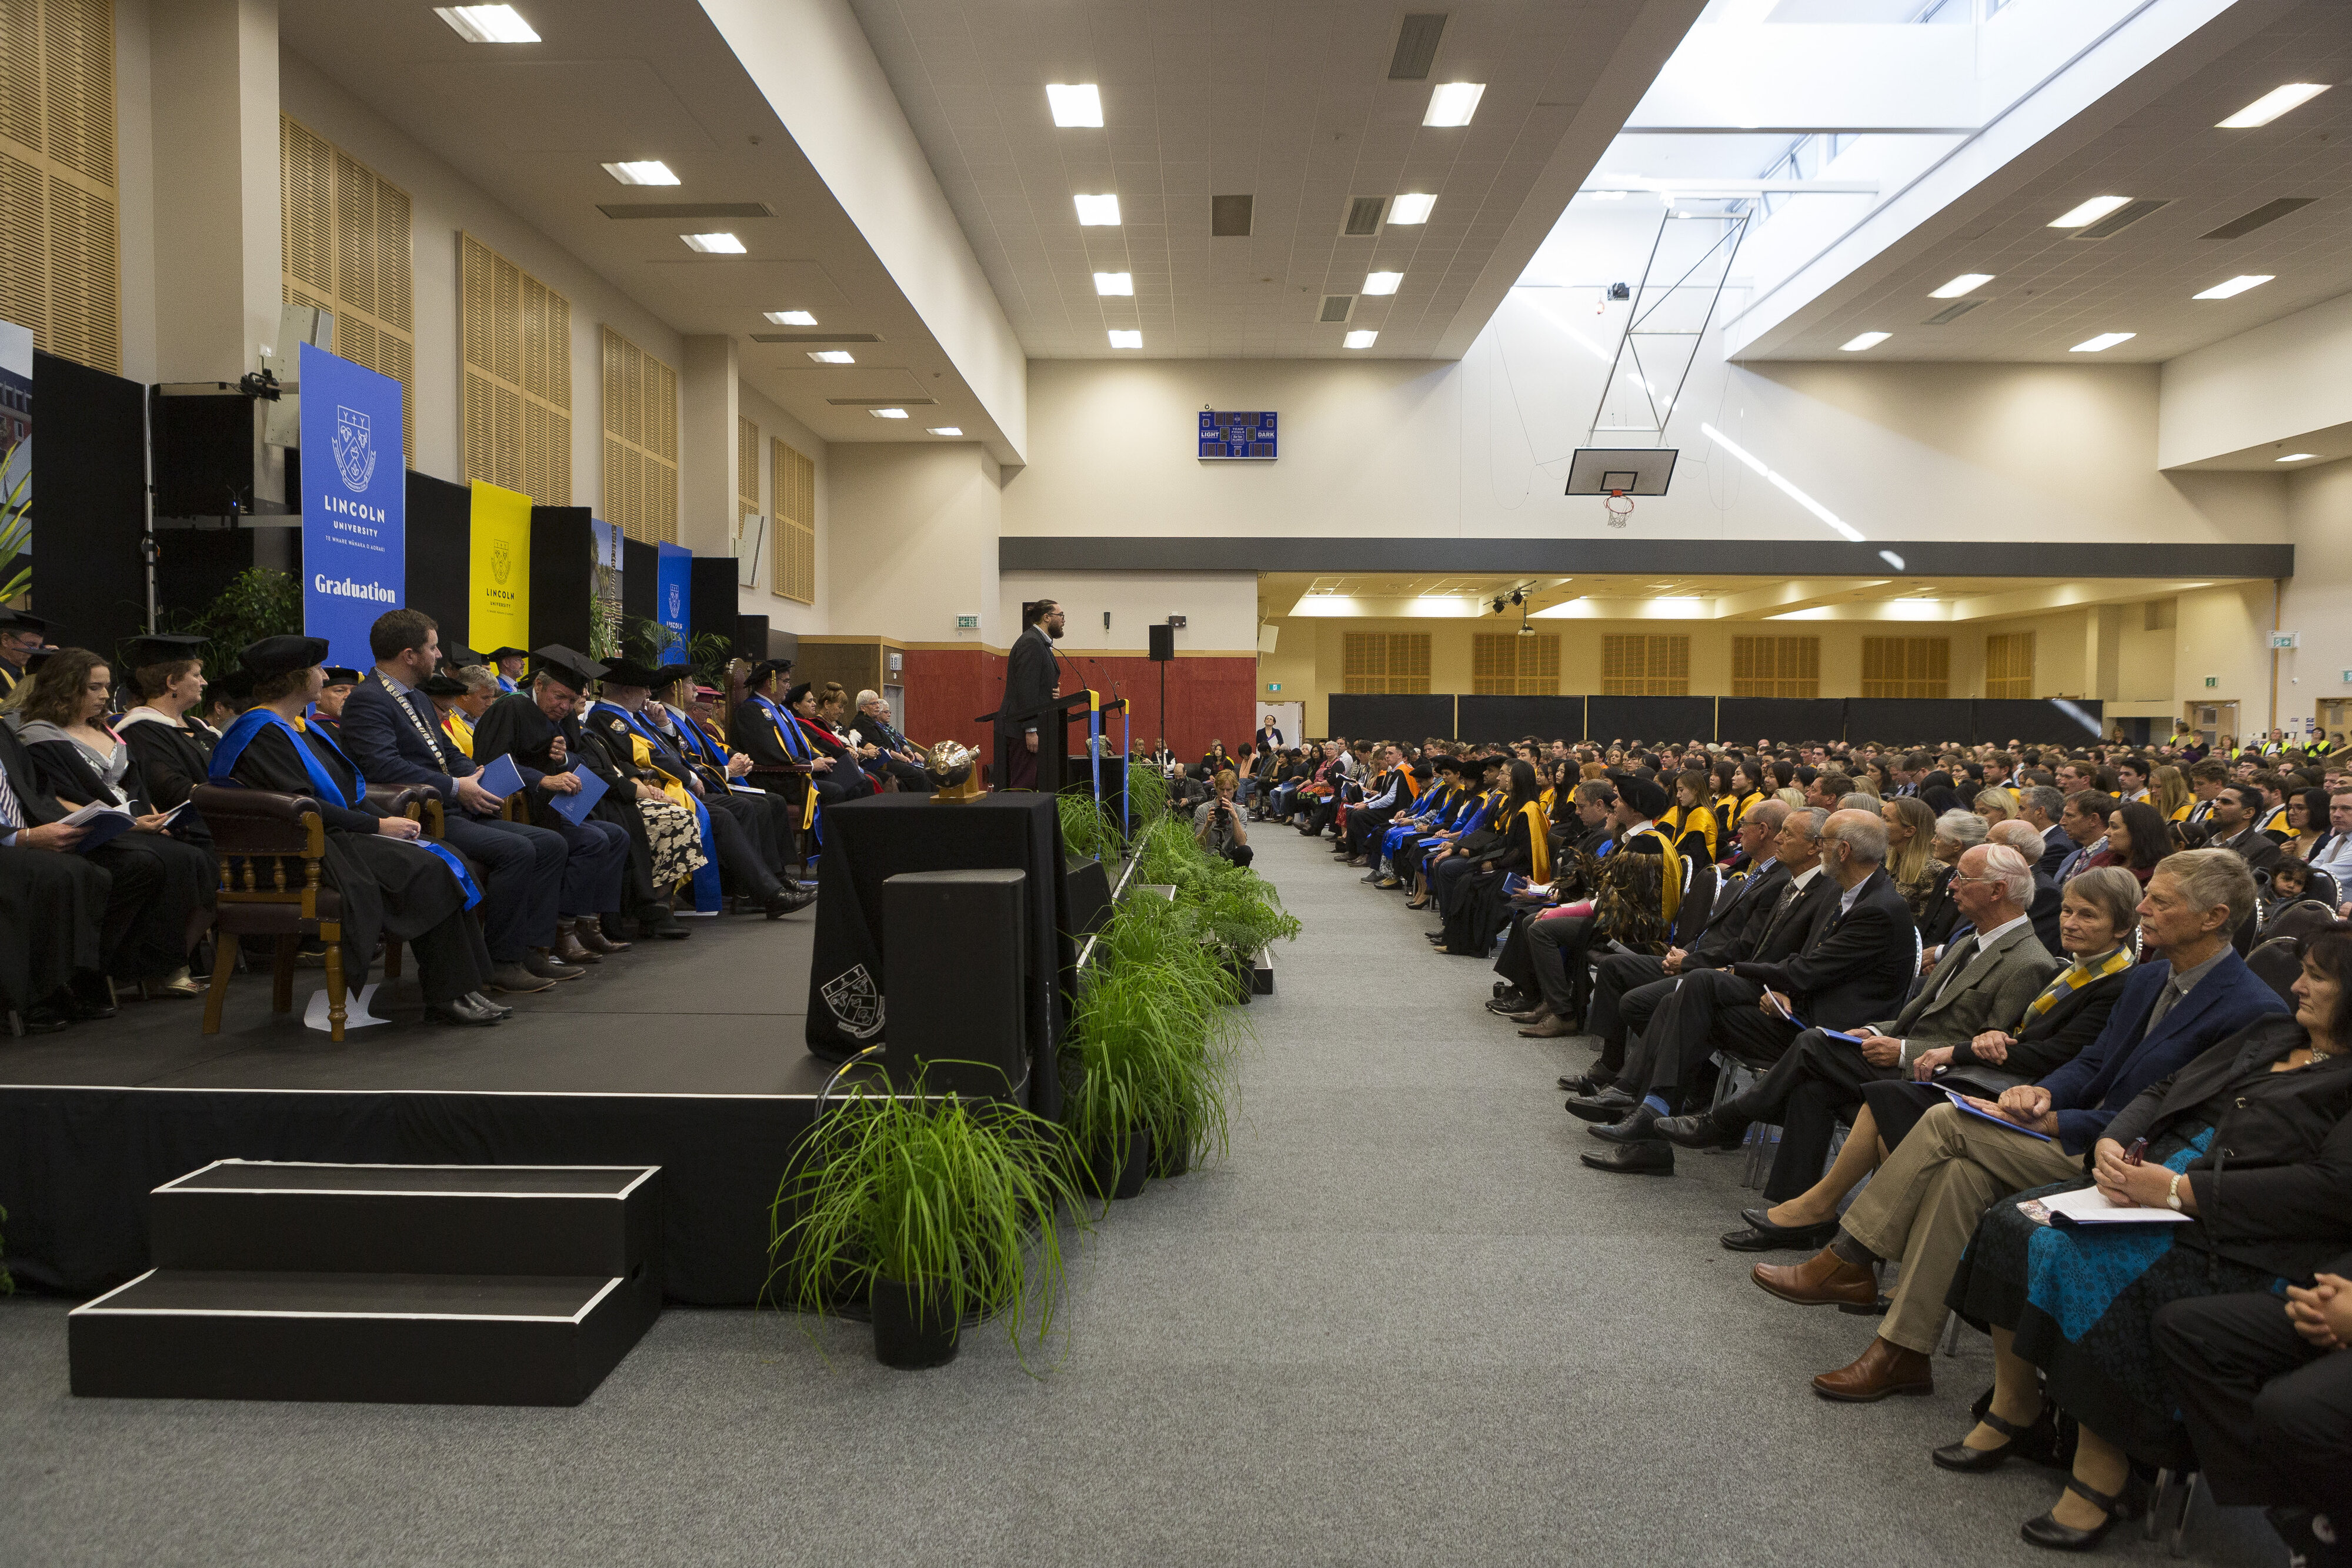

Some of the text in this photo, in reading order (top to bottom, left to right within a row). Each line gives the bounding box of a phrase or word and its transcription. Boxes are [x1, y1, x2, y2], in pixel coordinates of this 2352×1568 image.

[325, 495, 385, 524] LINCOLN
[333, 520, 378, 538] UNIVERSITY
[332, 536, 348, 545] WHARE
[315, 573, 396, 603] Graduation
[487, 588, 514, 599] LINCOLN
[666, 621, 682, 629] LINCOLN
